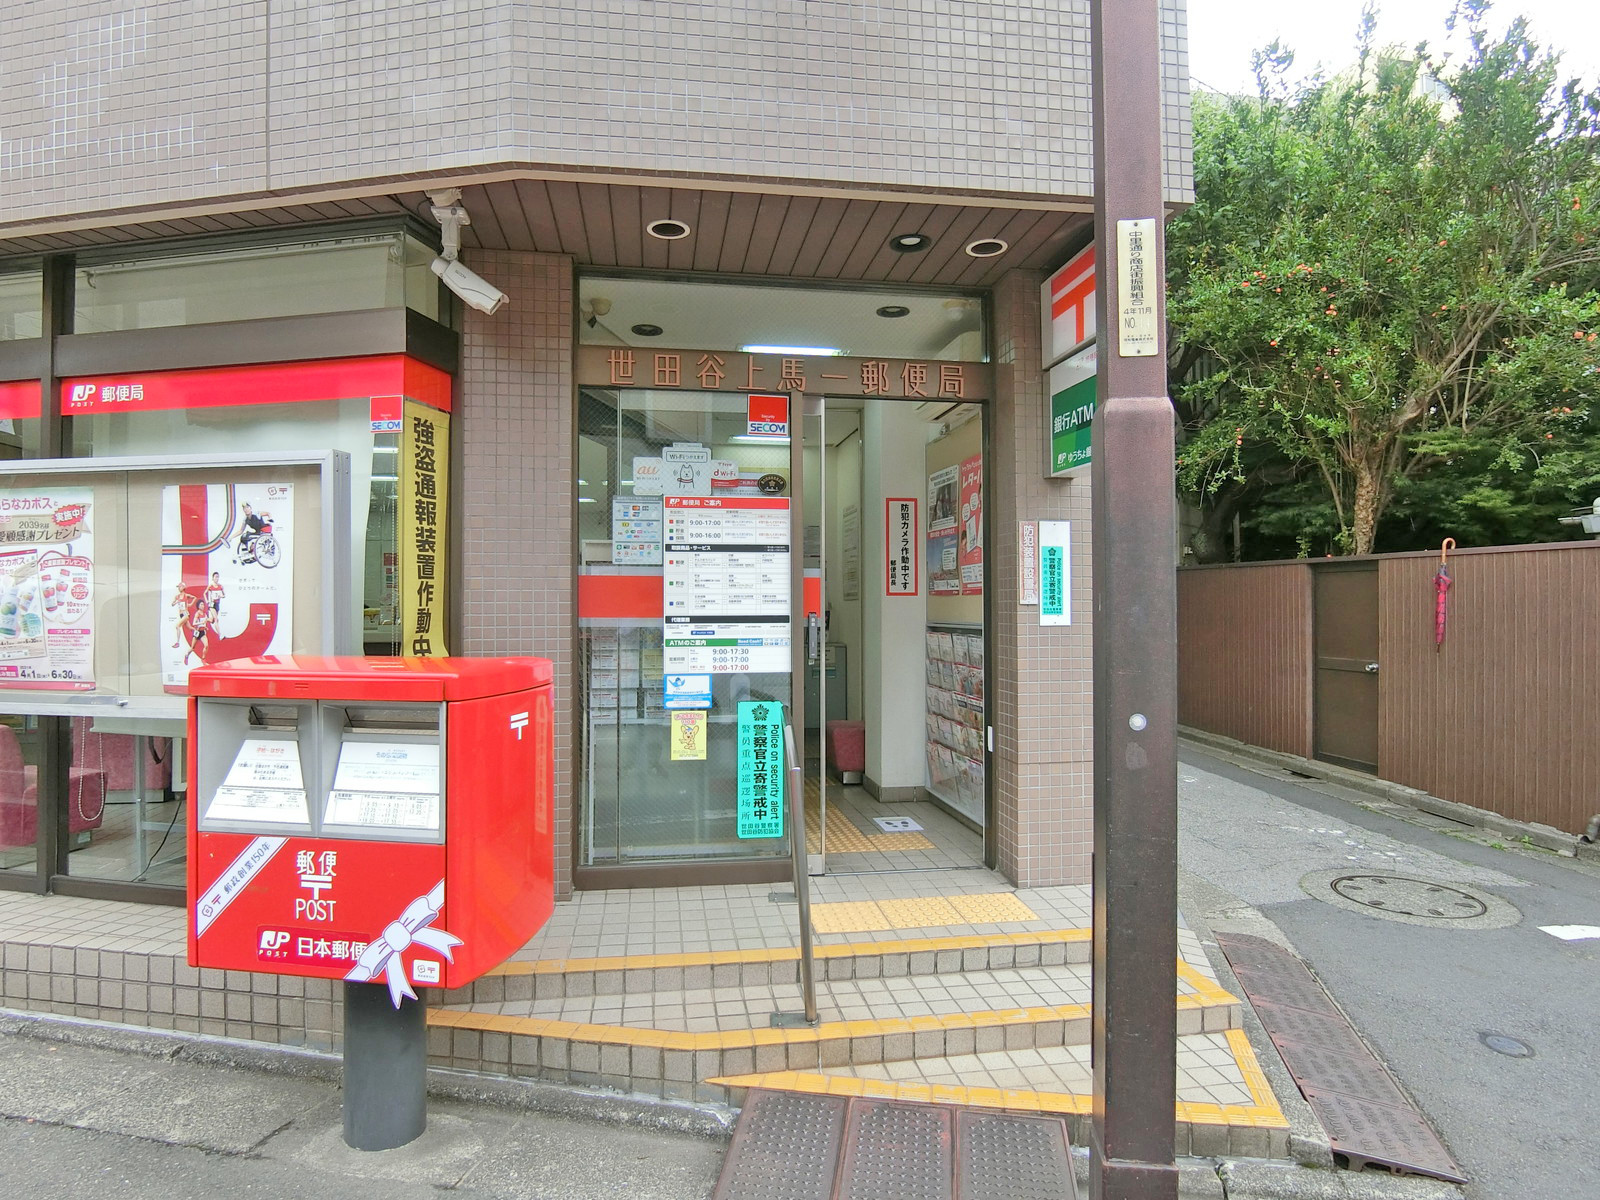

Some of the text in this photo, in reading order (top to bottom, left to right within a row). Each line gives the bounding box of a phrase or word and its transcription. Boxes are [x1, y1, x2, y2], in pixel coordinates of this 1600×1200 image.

[1129, 231, 1144, 306] 中里通り商店街振興組合
[607, 349, 966, 398] 世田谷上馬一郵便局
[102, 384, 144, 403] 郵便局
[371, 421, 401, 431] SECOM
[750, 423, 786, 434] SECOM
[1054, 402, 1094, 434] 銀行ATM
[637, 465, 659, 475] au
[0, 496, 59, 511] らなカボスと
[413, 416, 437, 657] 強盗通報装置作動中
[900, 503, 910, 591] 防犯カメラ作動中です
[753, 724, 768, 821] 警察官立寄警戒中
[769, 724, 780, 820] Police on security alert
[223, 841, 271, 895] 郵政創業150年
[296, 850, 337, 877] 郵便
[294, 898, 337, 922] POST
[258, 949, 289, 958] POST
[298, 936, 368, 961] 日本郵便
